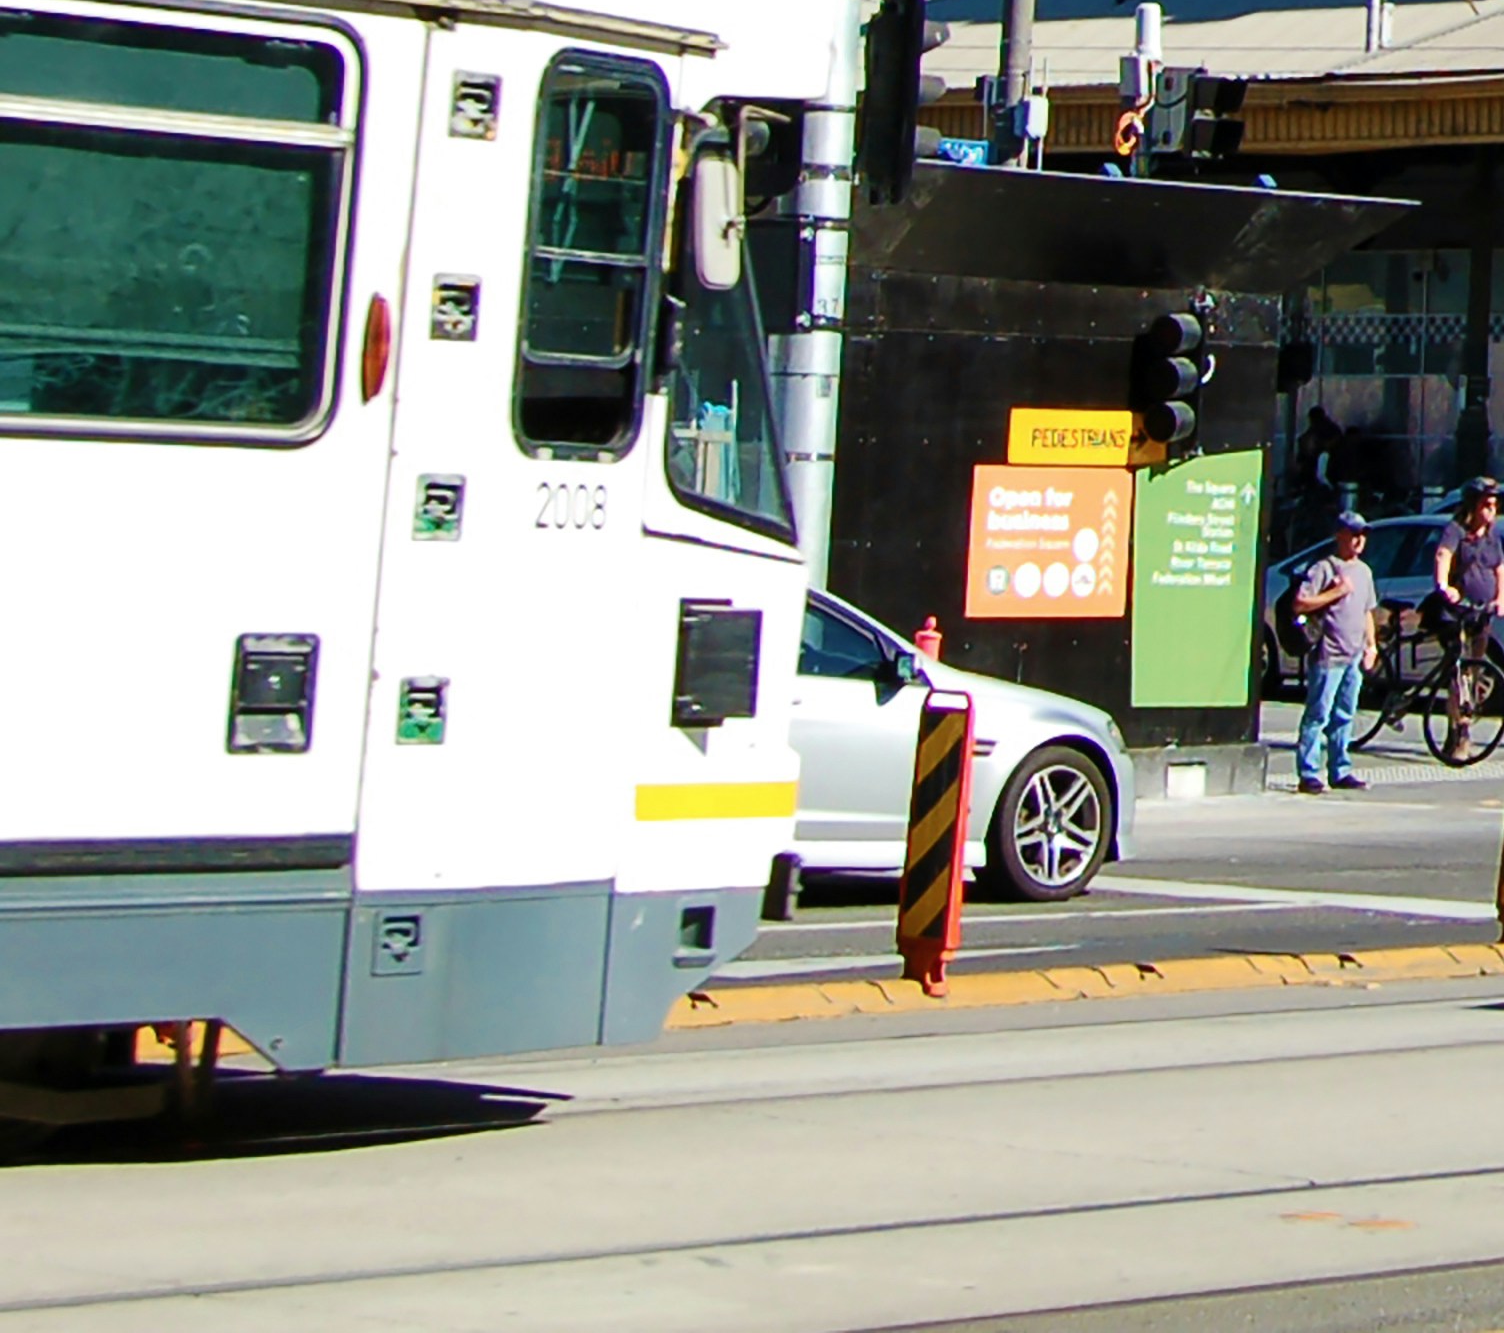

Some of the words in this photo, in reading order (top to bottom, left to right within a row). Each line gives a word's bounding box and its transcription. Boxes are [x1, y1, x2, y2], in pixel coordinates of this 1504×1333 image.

[1031, 428, 1126, 448] PEDESTRIANS
[535, 482, 607, 530] 2008
[989, 486, 1042, 510] Open
